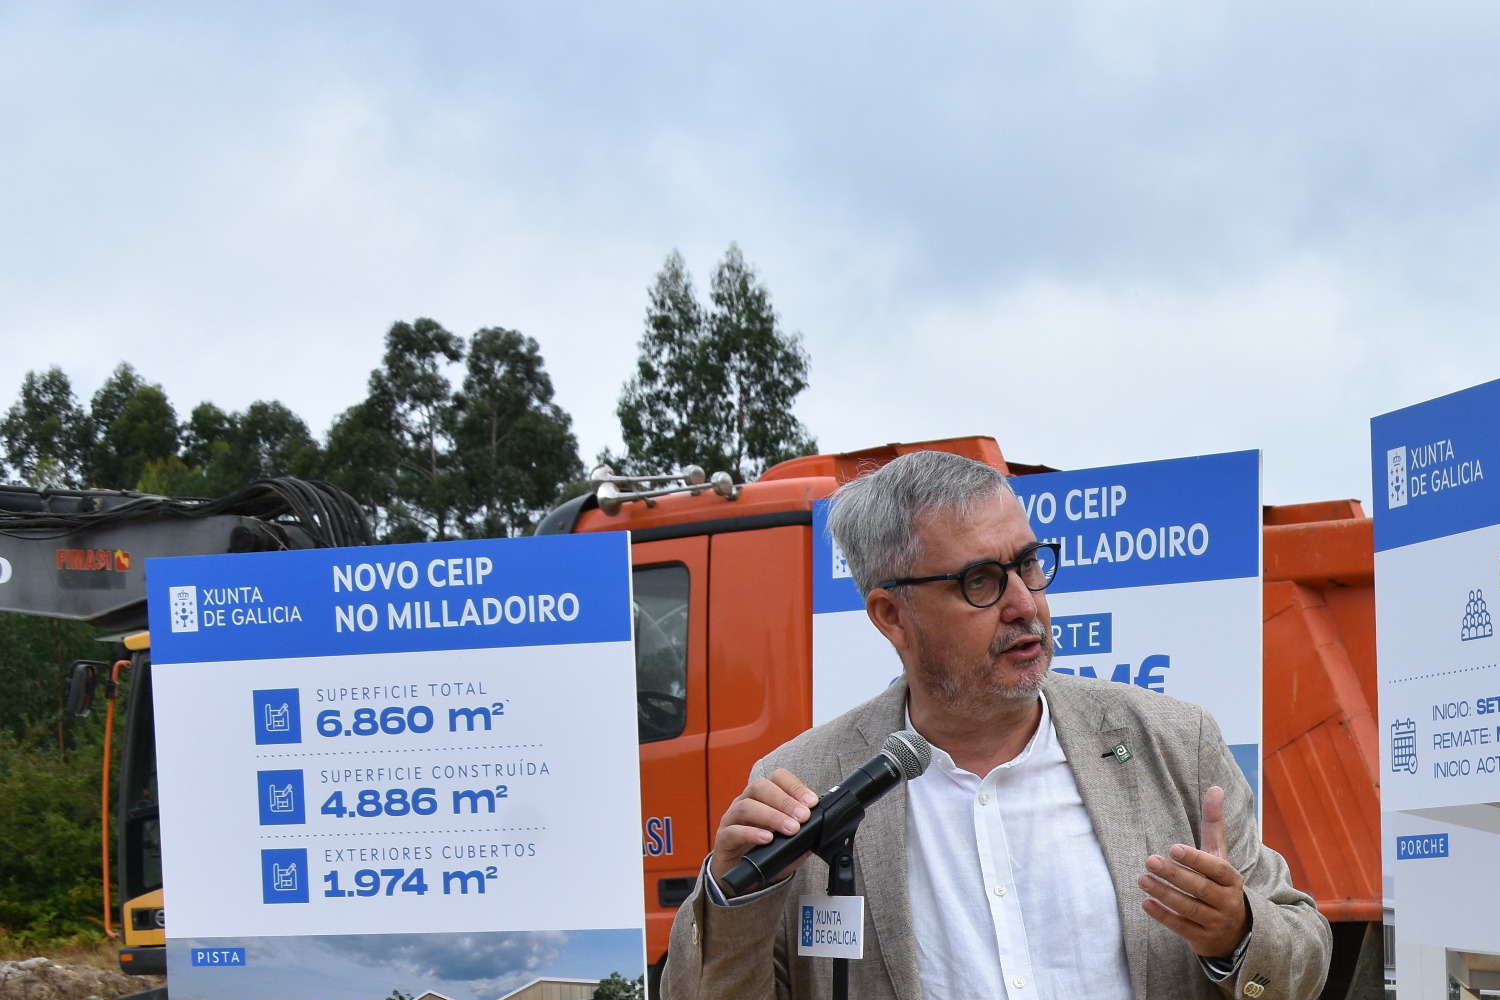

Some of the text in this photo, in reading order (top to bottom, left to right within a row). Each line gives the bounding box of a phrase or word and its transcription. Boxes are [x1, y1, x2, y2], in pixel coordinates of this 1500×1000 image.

[1410, 439, 1455, 470] XUNTA
[1411, 459, 1484, 498] DE GALICIA
[1017, 485, 1127, 525] VO CEIP
[1043, 523, 1210, 568] LLADOIRO
[333, 556, 493, 593] NOVO CEIP
[203, 586, 264, 606] XUNTA
[203, 605, 303, 627] DE GALICIA
[335, 592, 580, 633] NO MILLADOIRO
[316, 682, 487, 703] SUPERFICIE TOTAL
[316, 705, 434, 738] 6.860
[1432, 700, 1472, 722] INICIO:
[1433, 728, 1491, 750] REMATE:
[320, 758, 550, 784] SUPERFICIE CONSTRUÍDA
[1433, 759, 1471, 779] INICIO
[320, 787, 438, 819] 4.886
[324, 842, 536, 863] EXTERIORES CUBERTOS
[1400, 838, 1445, 856] PORCHE
[323, 867, 429, 898] 1.974
[815, 909, 842, 926] XUNTA
[815, 929, 857, 946] DE GALICIA
[197, 951, 240, 964] PISTA
